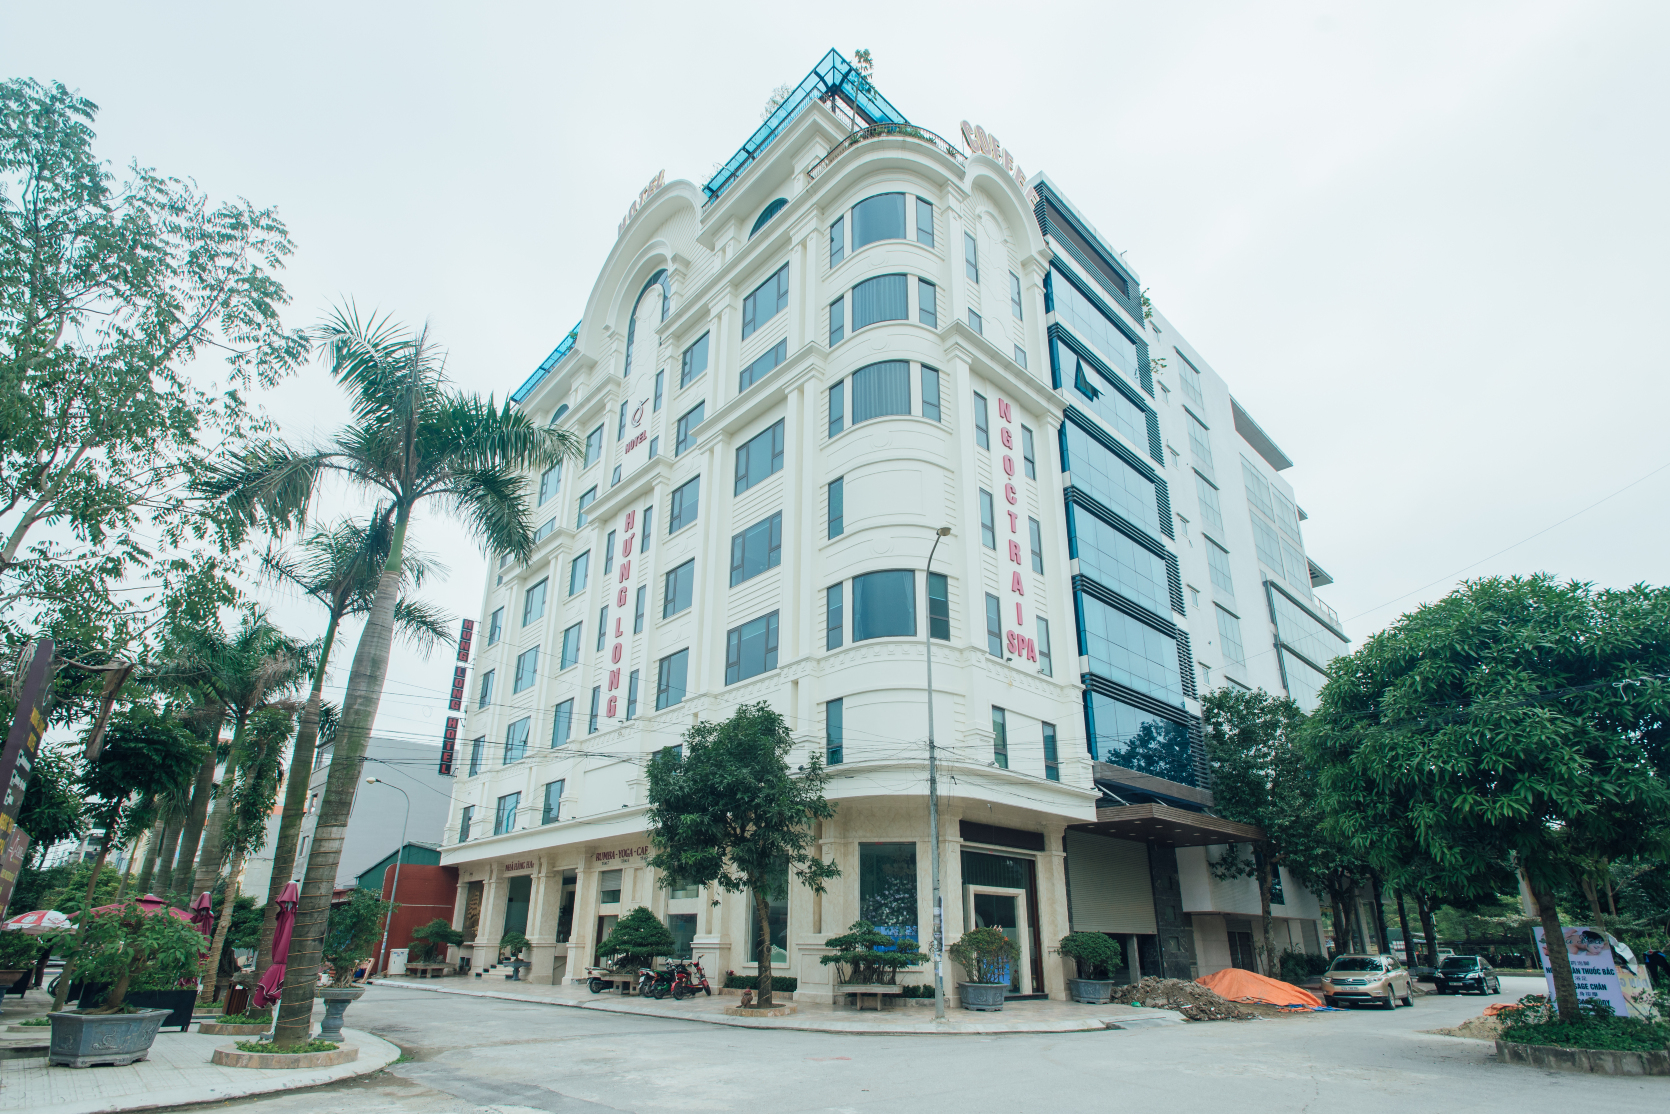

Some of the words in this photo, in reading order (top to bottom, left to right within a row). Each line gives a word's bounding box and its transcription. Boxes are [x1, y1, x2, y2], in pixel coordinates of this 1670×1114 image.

[625, 430, 648, 454] HOTEL
[606, 616, 623, 718] LONG
[1006, 629, 1038, 663] SPA
[450, 667, 465, 710] LONG
[441, 718, 458, 774] HOTEL
